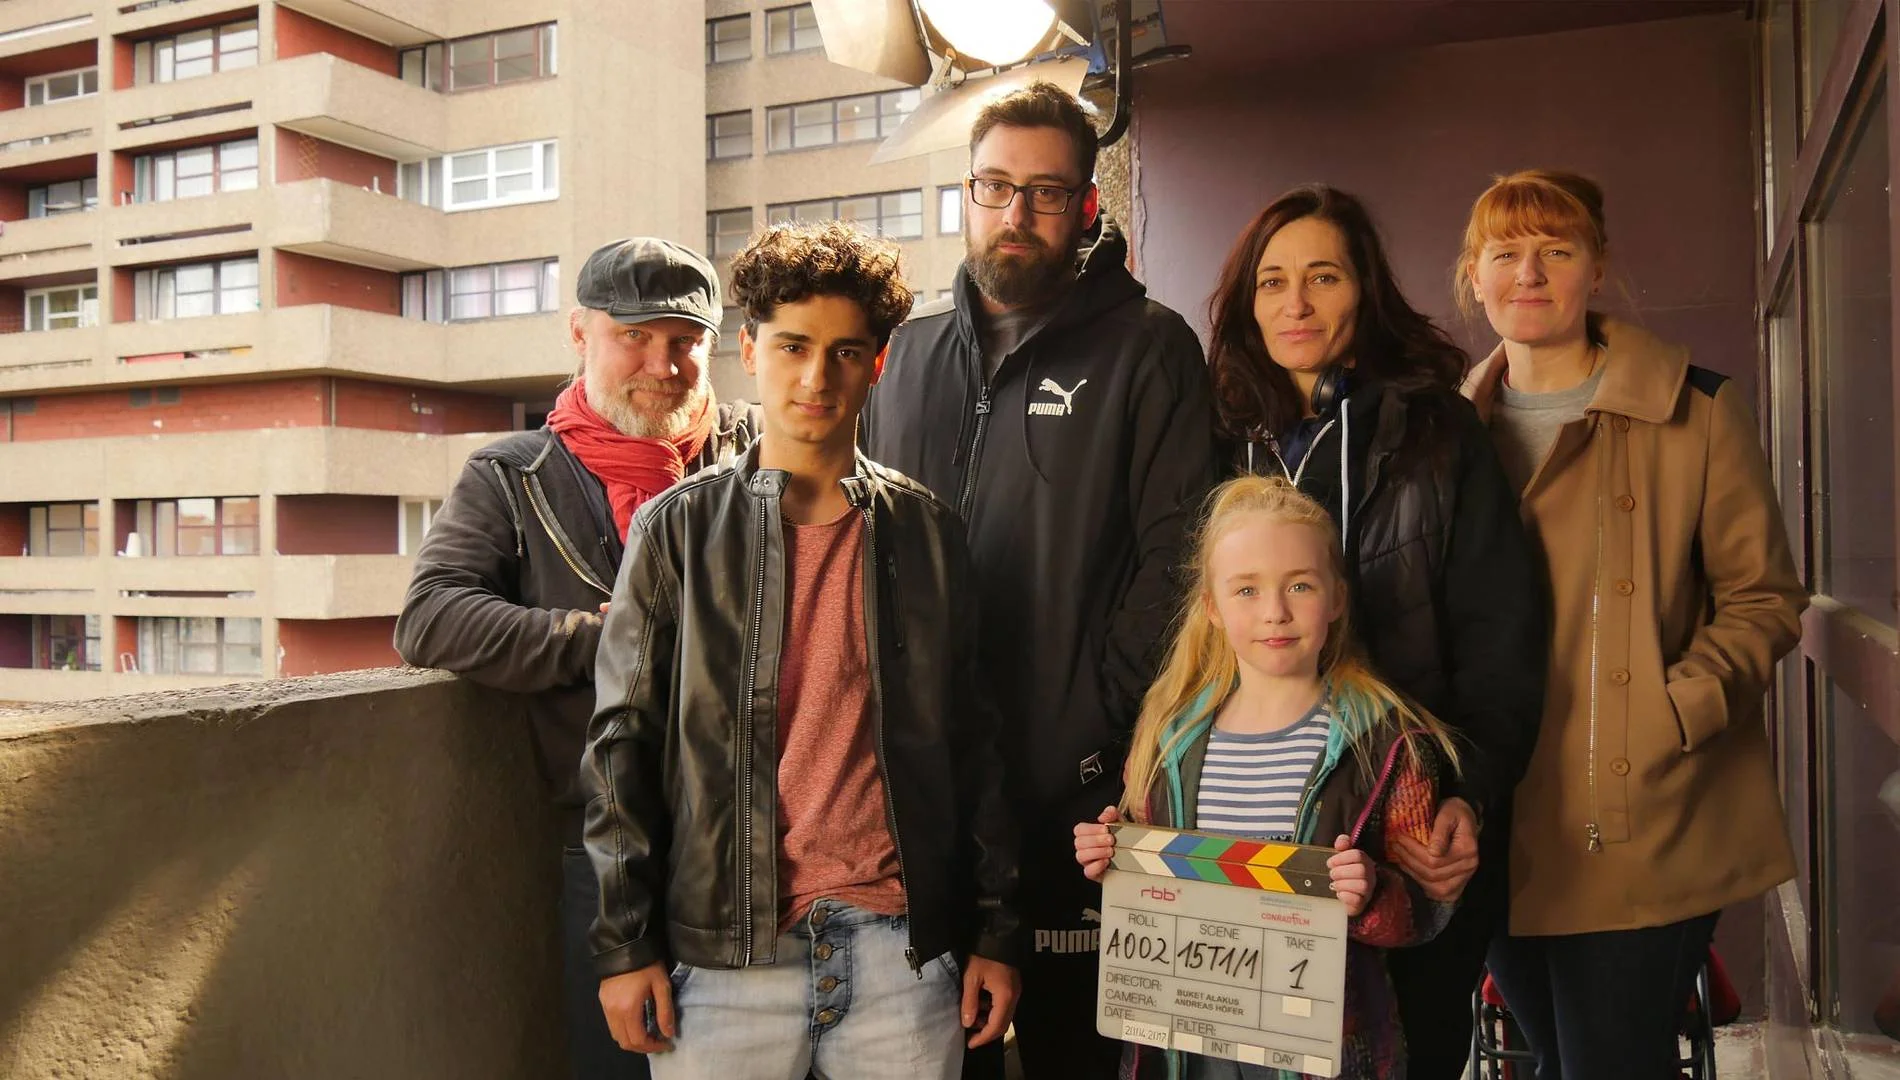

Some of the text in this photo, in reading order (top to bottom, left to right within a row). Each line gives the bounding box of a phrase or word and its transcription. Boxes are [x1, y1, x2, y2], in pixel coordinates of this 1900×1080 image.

[1028, 402, 1065, 416] PUMA
[1128, 913, 1158, 928] ROLL
[1200, 924, 1239, 940] SCENE
[1106, 928, 1170, 964] A002
[1284, 936, 1315, 951] TAKE
[1289, 959, 1308, 990] 1
[1105, 971, 1162, 991] DIRECTOR:
[1176, 989, 1204, 1000] BUKET
[1105, 988, 1157, 1007] CAMERA:
[1174, 998, 1214, 1012] ANDREAS
[1176, 1018, 1217, 1037] FILTER:
[1211, 1041, 1230, 1055] INT
[1272, 1052, 1296, 1066] DAY
